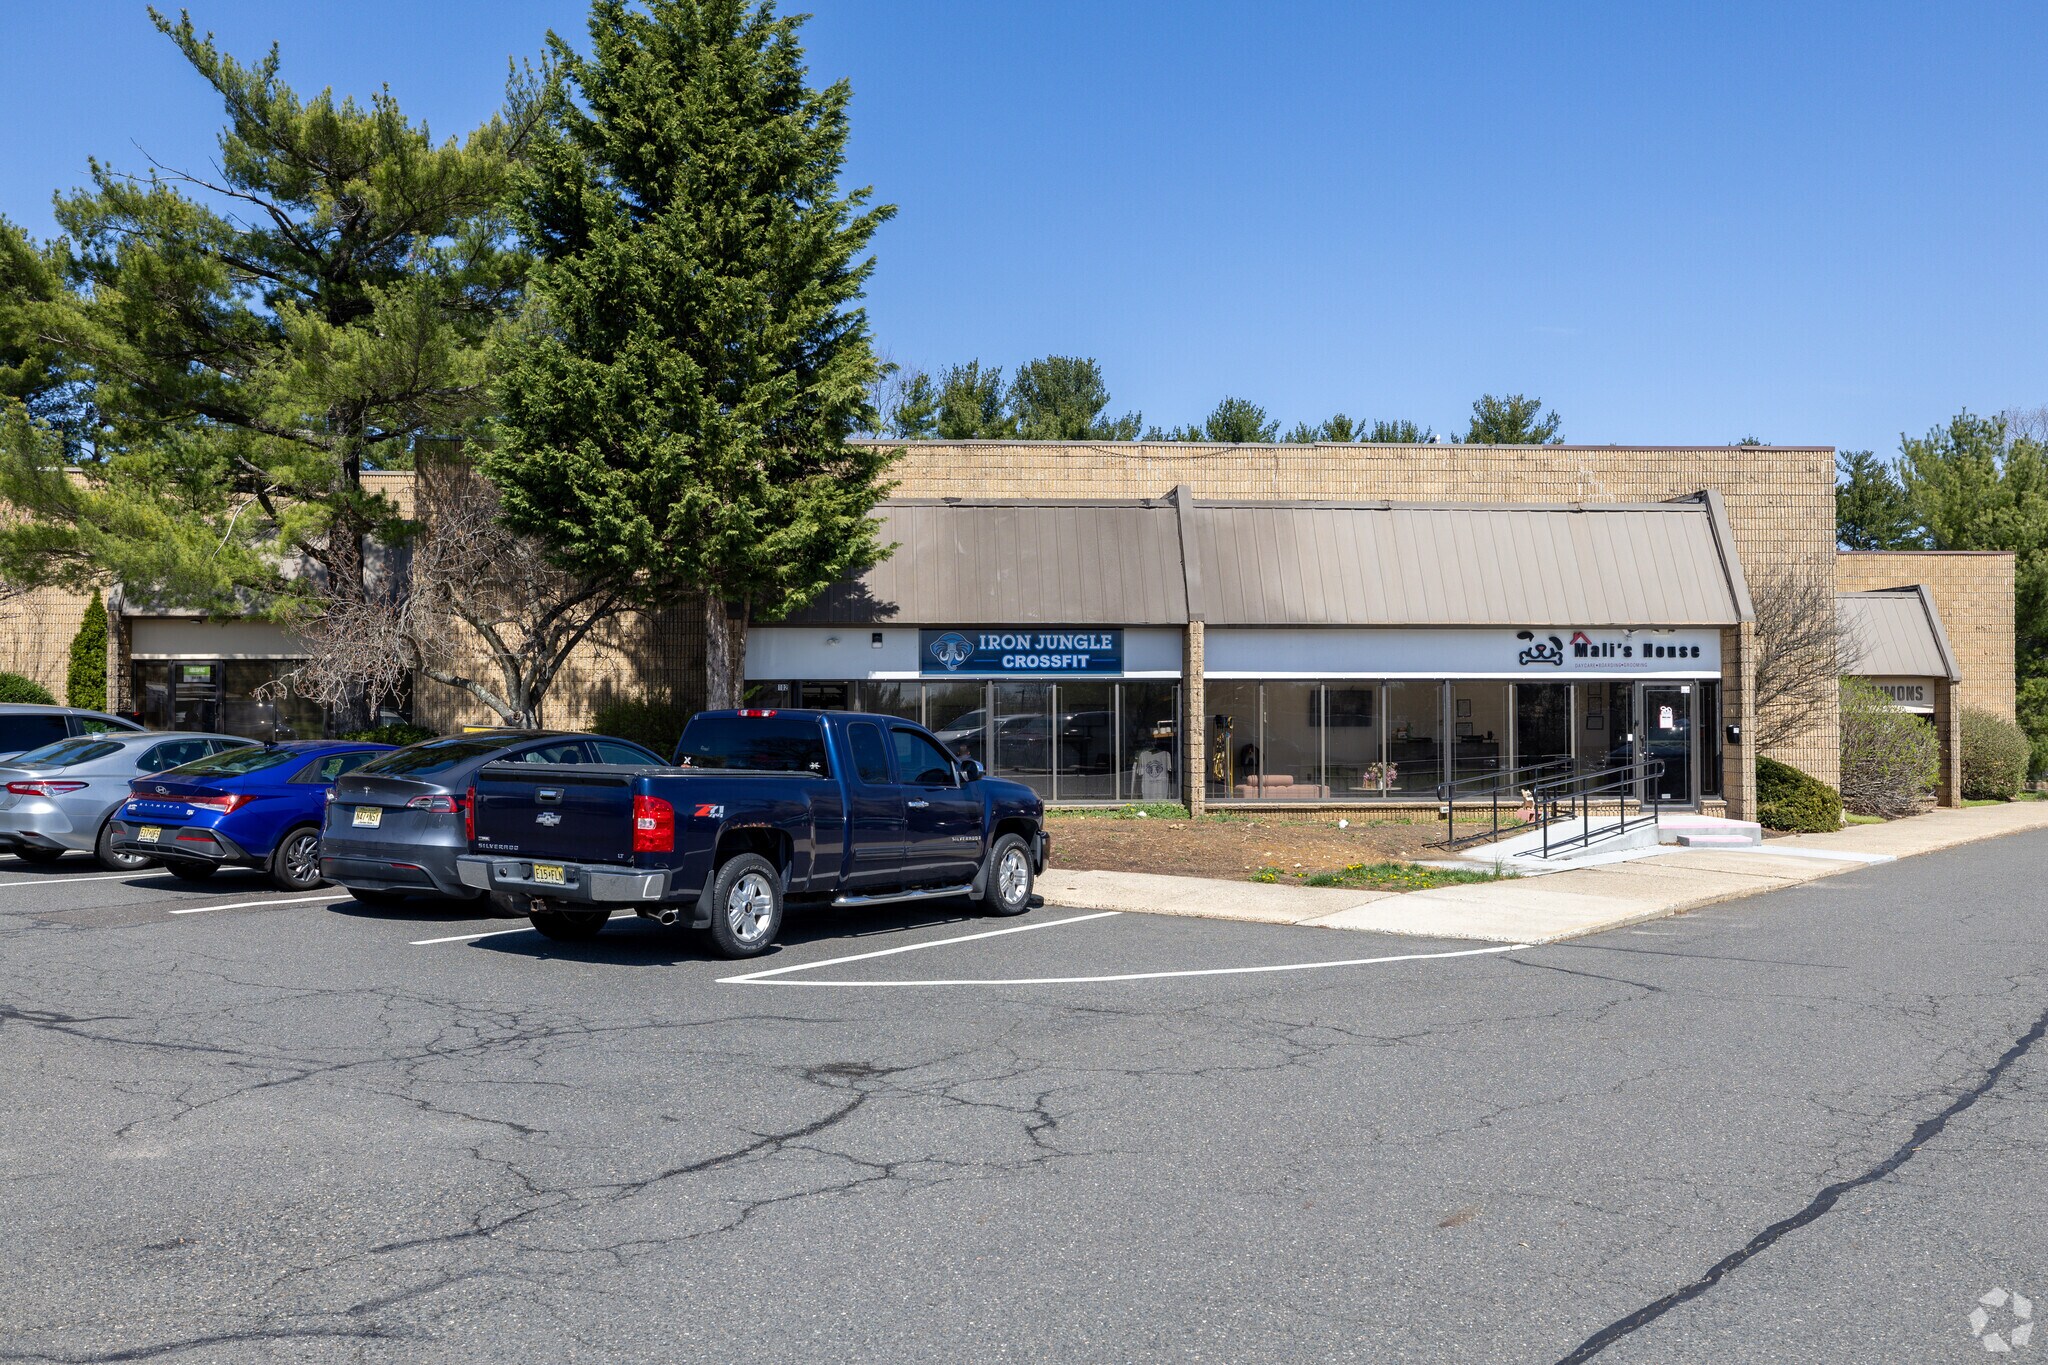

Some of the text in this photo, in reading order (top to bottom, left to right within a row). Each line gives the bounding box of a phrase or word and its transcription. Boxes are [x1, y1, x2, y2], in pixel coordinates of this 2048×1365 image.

[979, 634, 1112, 650] IRON JUNGLE
[1574, 642, 1700, 658] Mali's House
[1002, 655, 1090, 668] CROSSFIT
[694, 803, 725, 817] Z71
[478, 842, 519, 851] SILVERADO
